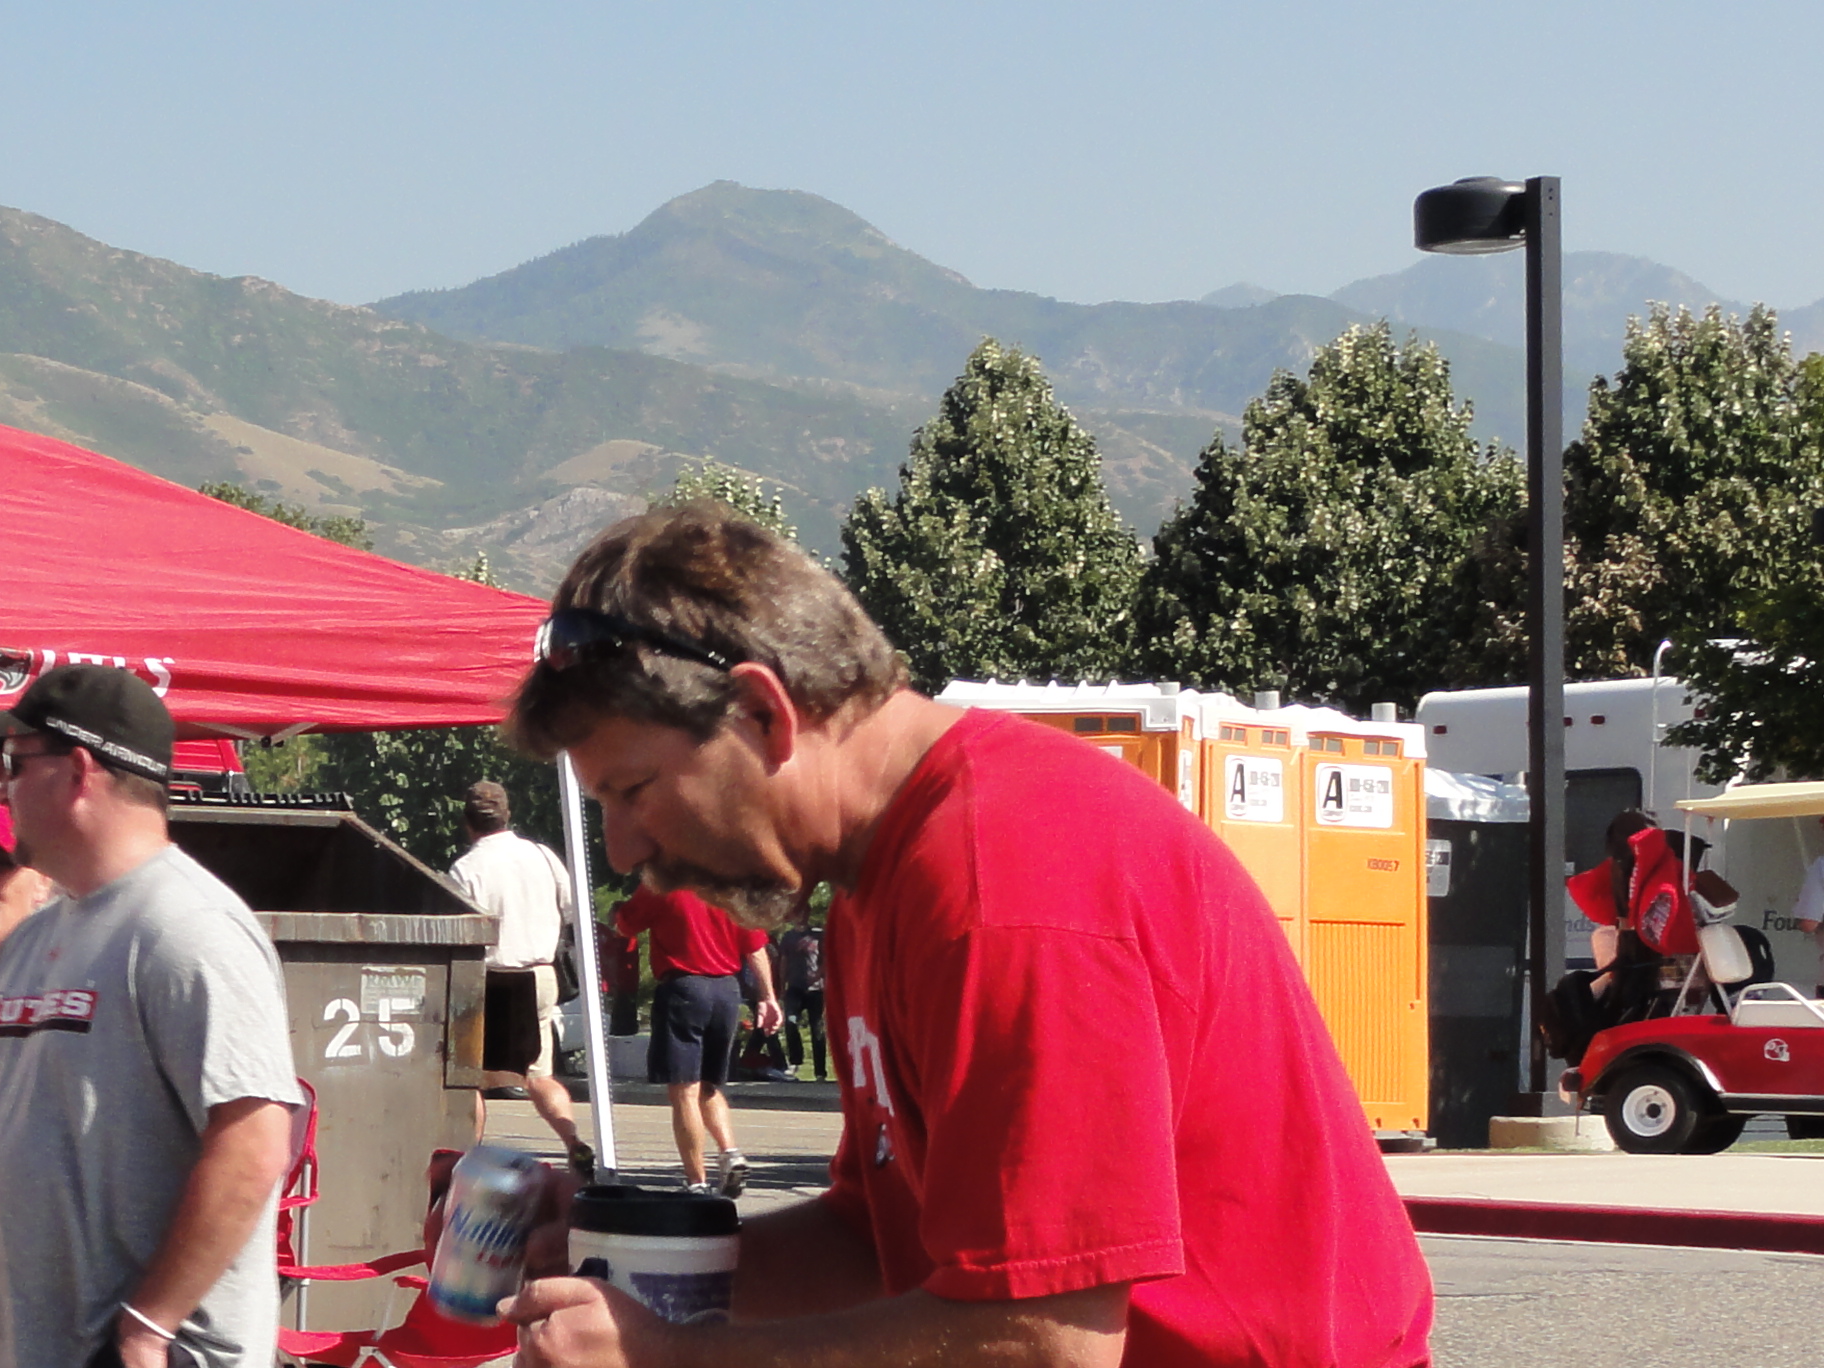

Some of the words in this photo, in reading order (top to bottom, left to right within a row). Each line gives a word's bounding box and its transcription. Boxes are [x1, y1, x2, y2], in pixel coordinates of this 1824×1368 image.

[1322, 770, 1344, 809] A
[1762, 909, 1800, 930] Fou
[0, 990, 95, 1023] UTES
[323, 998, 416, 1058] 25
